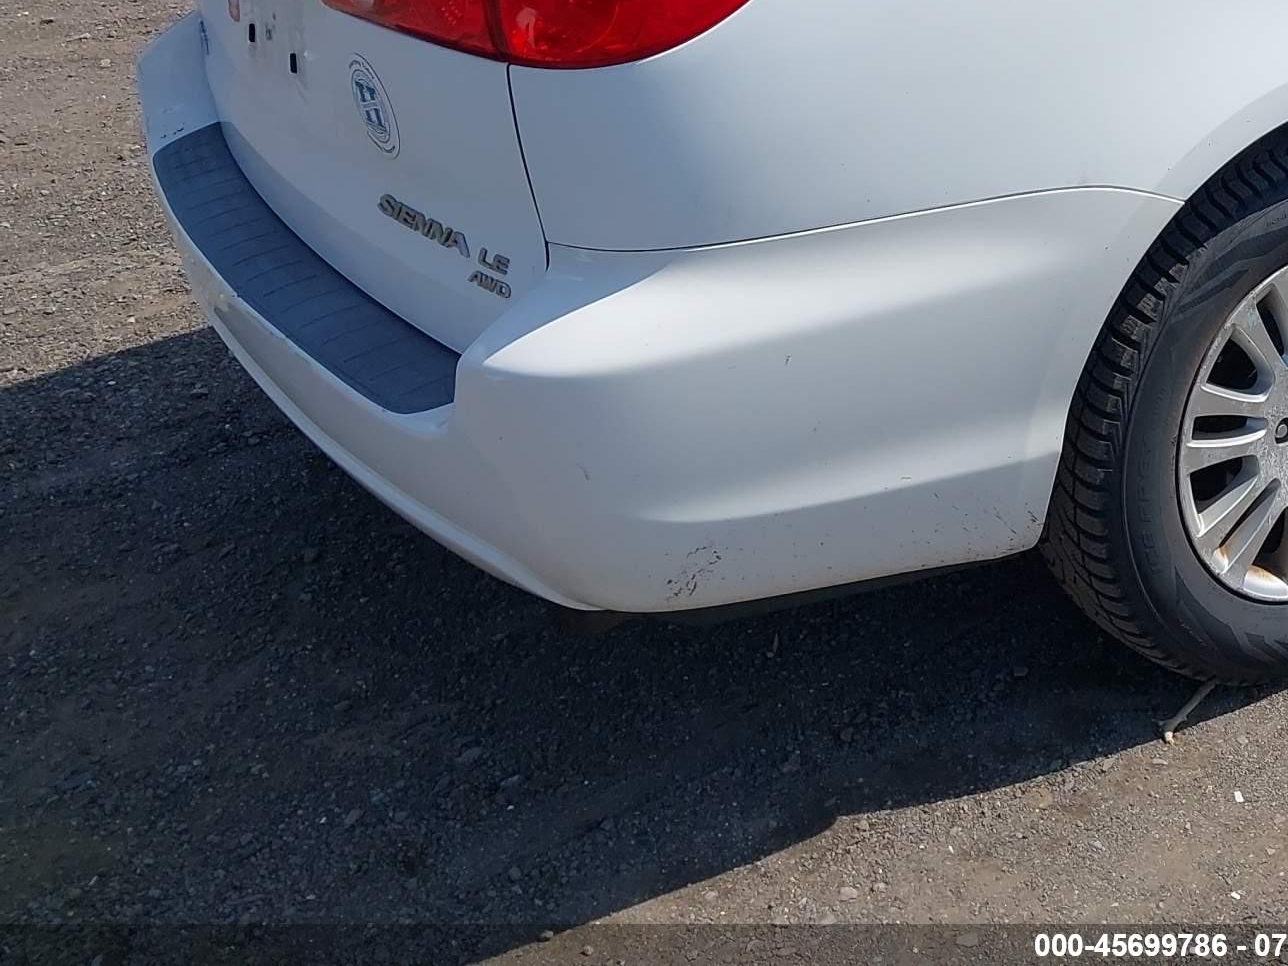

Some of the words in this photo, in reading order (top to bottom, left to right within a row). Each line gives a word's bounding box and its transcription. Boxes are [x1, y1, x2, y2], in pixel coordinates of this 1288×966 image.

[377, 193, 470, 259] SIENNA
[478, 247, 510, 275] LE
[467, 270, 512, 299] AWD
